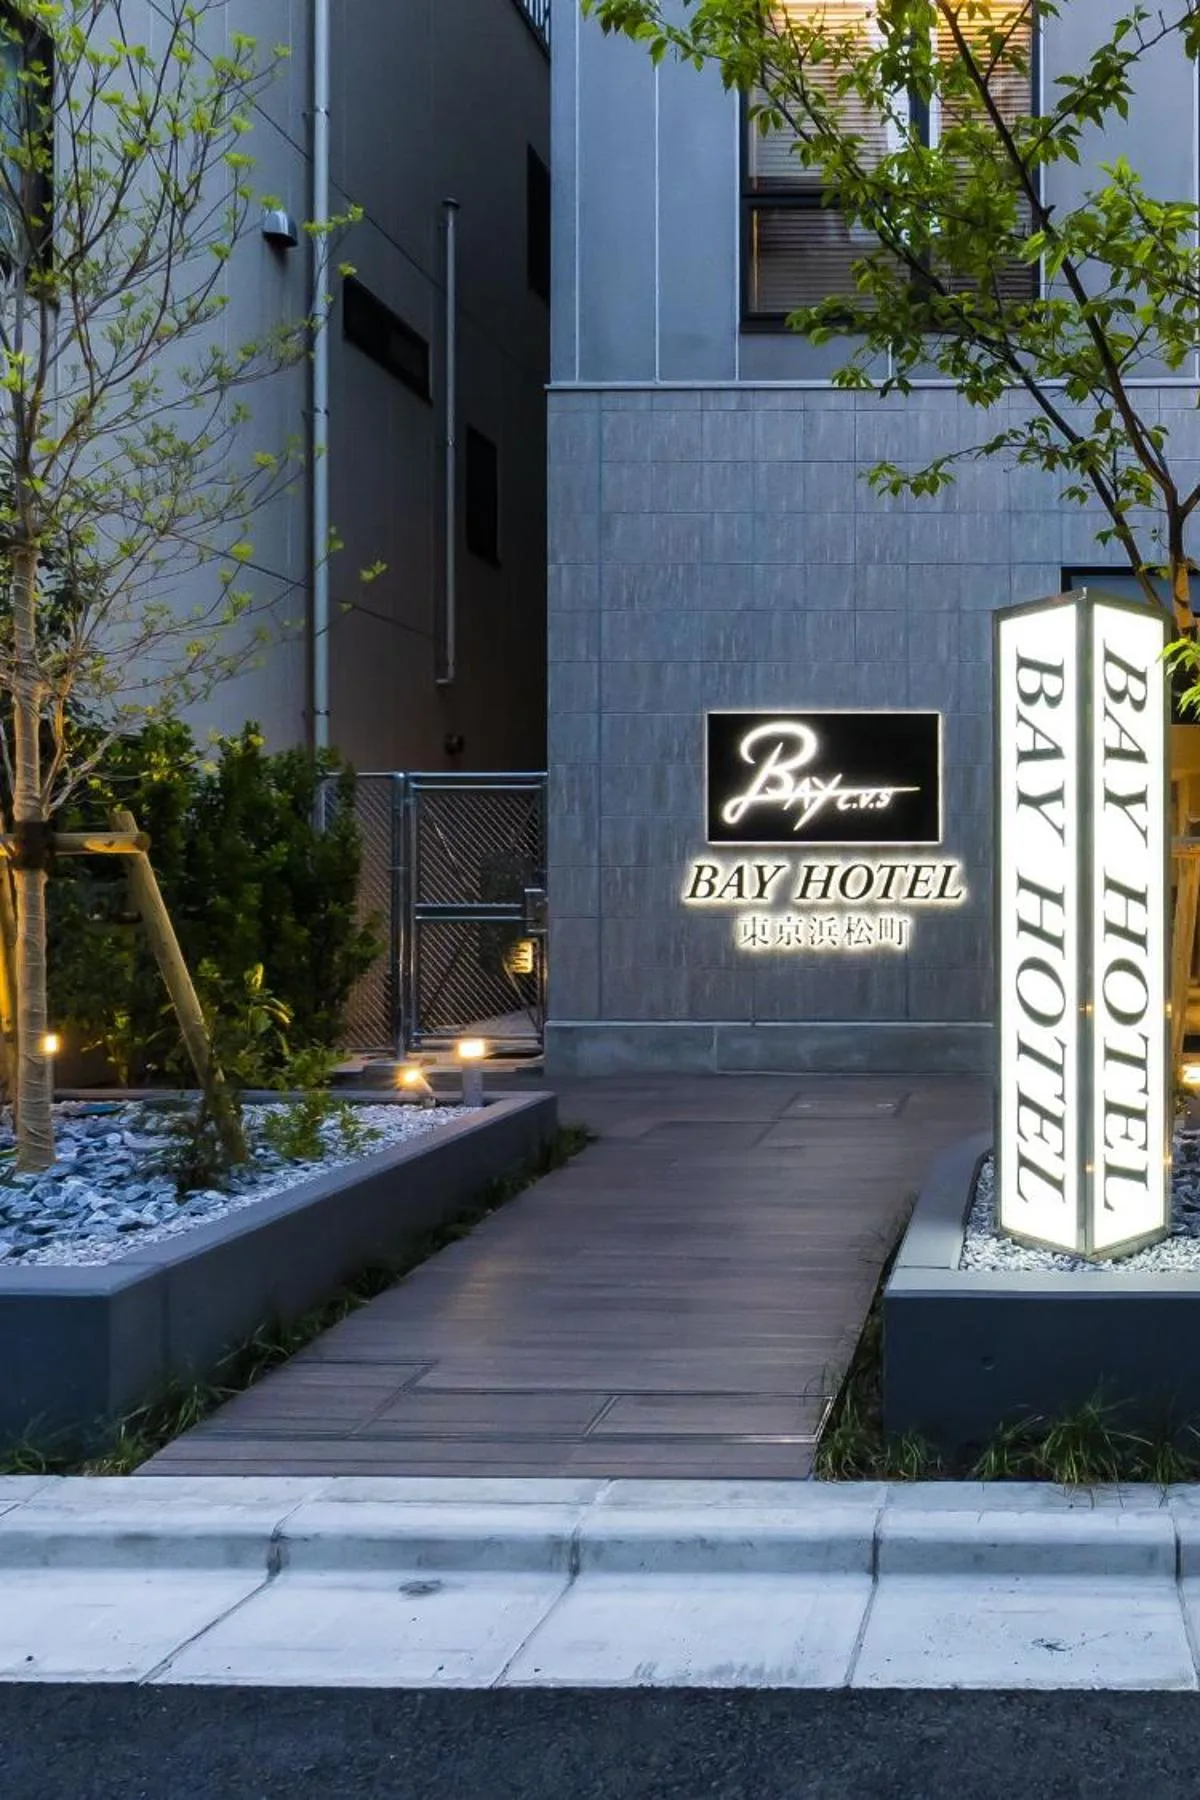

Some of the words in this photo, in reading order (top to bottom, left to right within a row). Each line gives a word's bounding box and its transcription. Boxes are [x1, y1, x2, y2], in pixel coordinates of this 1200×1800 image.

[1016, 644, 1066, 848] BAY
[1103, 638, 1148, 849] BAY
[685, 863, 786, 900] BAY
[795, 862, 964, 901] HOTEL
[739, 915, 910, 947] 東京浜松町
[1015, 866, 1067, 1204] HOTEL
[1102, 866, 1149, 1212] HOTEL
